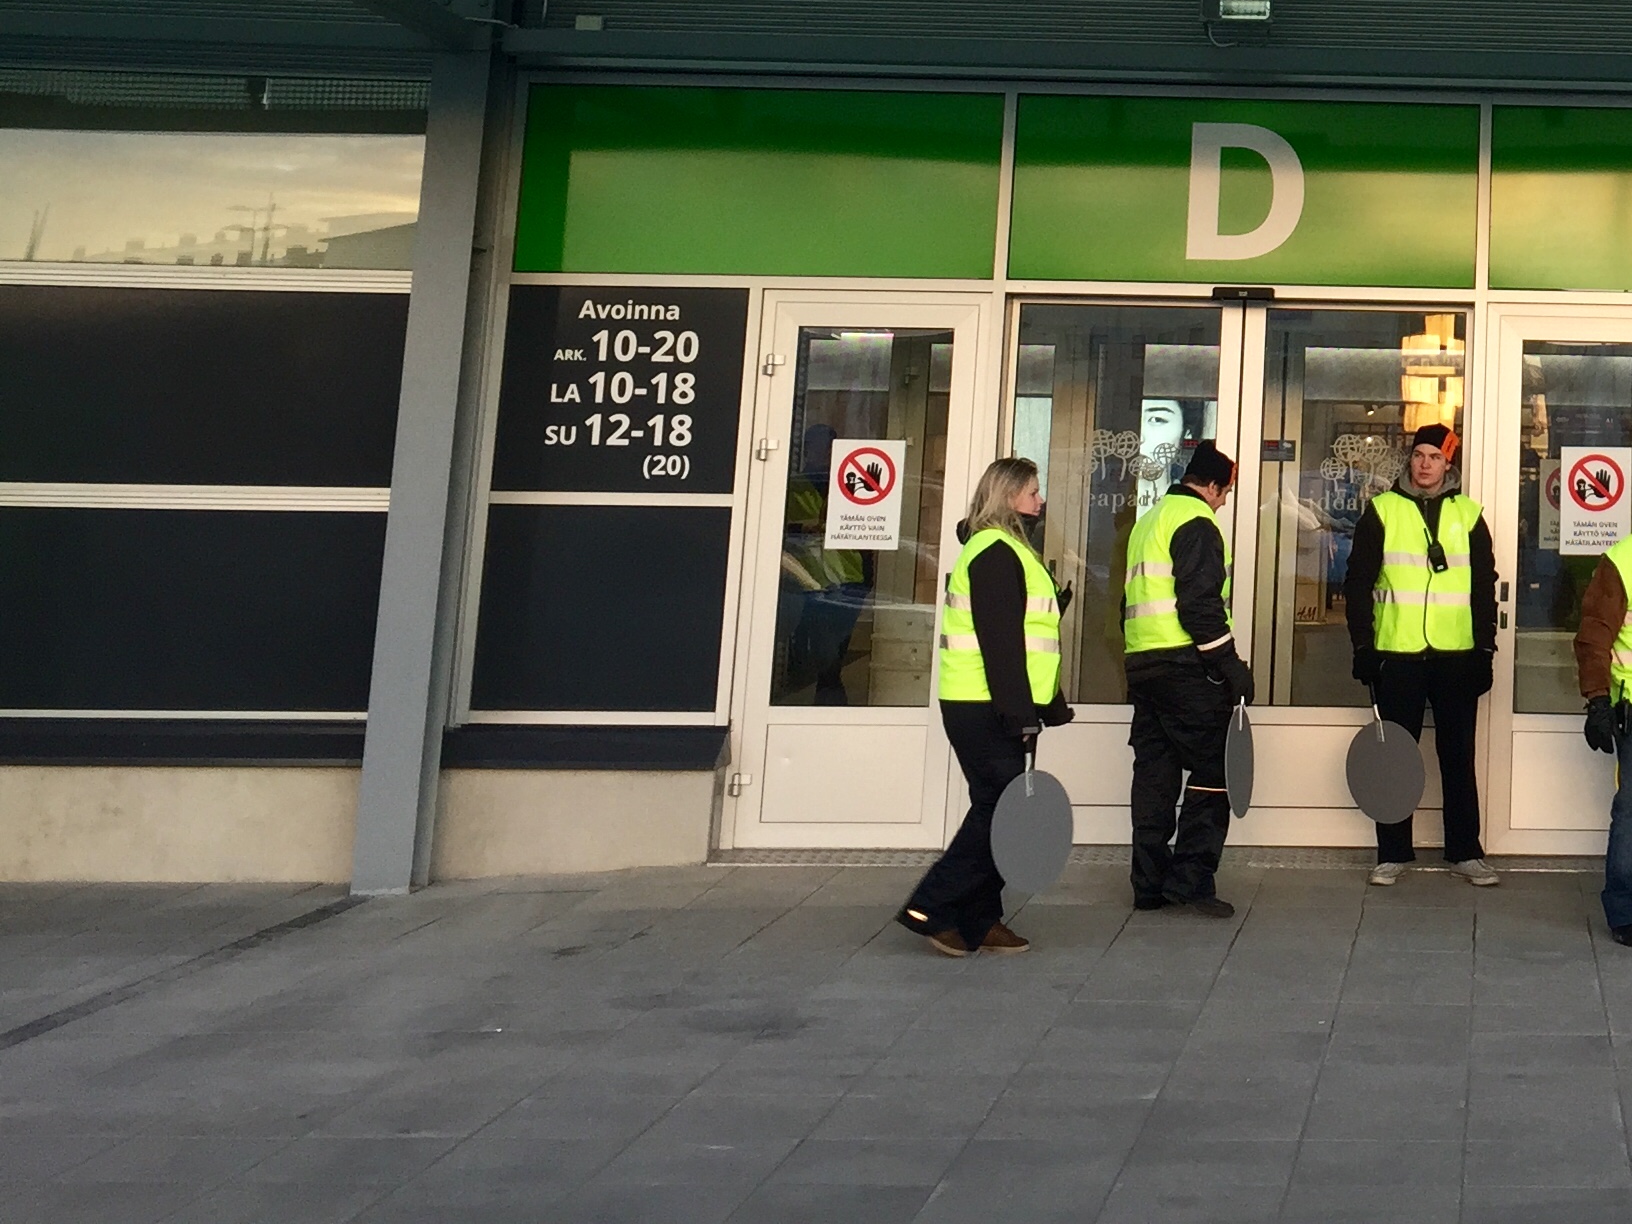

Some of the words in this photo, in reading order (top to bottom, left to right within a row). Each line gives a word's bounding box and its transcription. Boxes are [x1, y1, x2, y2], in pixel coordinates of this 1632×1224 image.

[1186, 121, 1305, 261] D
[578, 299, 680, 321] Avoinna
[553, 348, 587, 361] ARK.
[591, 329, 700, 363] 10-20
[550, 383, 581, 403] LA
[588, 371, 696, 404] 10-18
[544, 425, 577, 445] SU
[584, 413, 693, 447] 12-18
[642, 455, 690, 480] (20)
